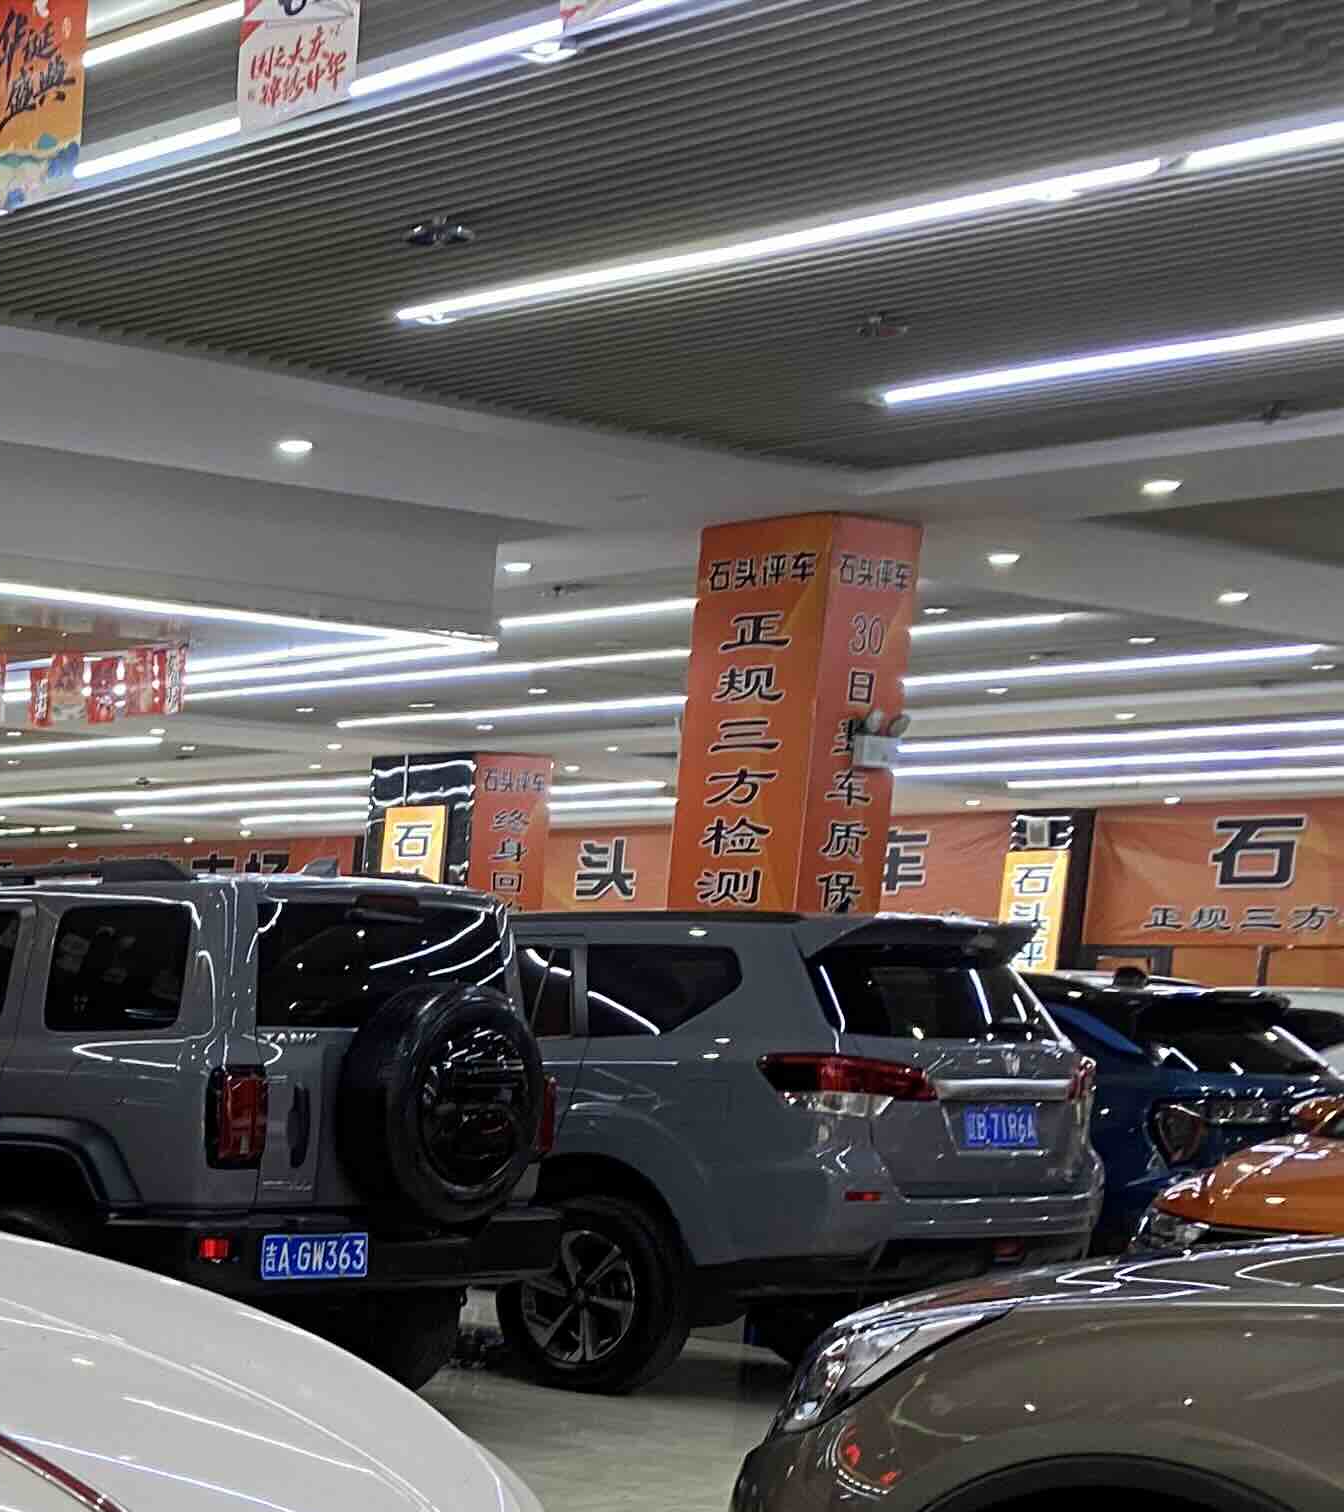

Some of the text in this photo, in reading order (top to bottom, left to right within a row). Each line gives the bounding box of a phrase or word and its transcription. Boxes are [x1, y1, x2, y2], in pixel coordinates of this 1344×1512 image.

[707, 551, 817, 592] 石头评车
[839, 552, 913, 591] 石头评车
[696, 610, 791, 906] 正规三方检测
[490, 808, 531, 912] 终身回
[1210, 814, 1308, 889] 石
[1144, 905, 1344, 932] 正规三方
